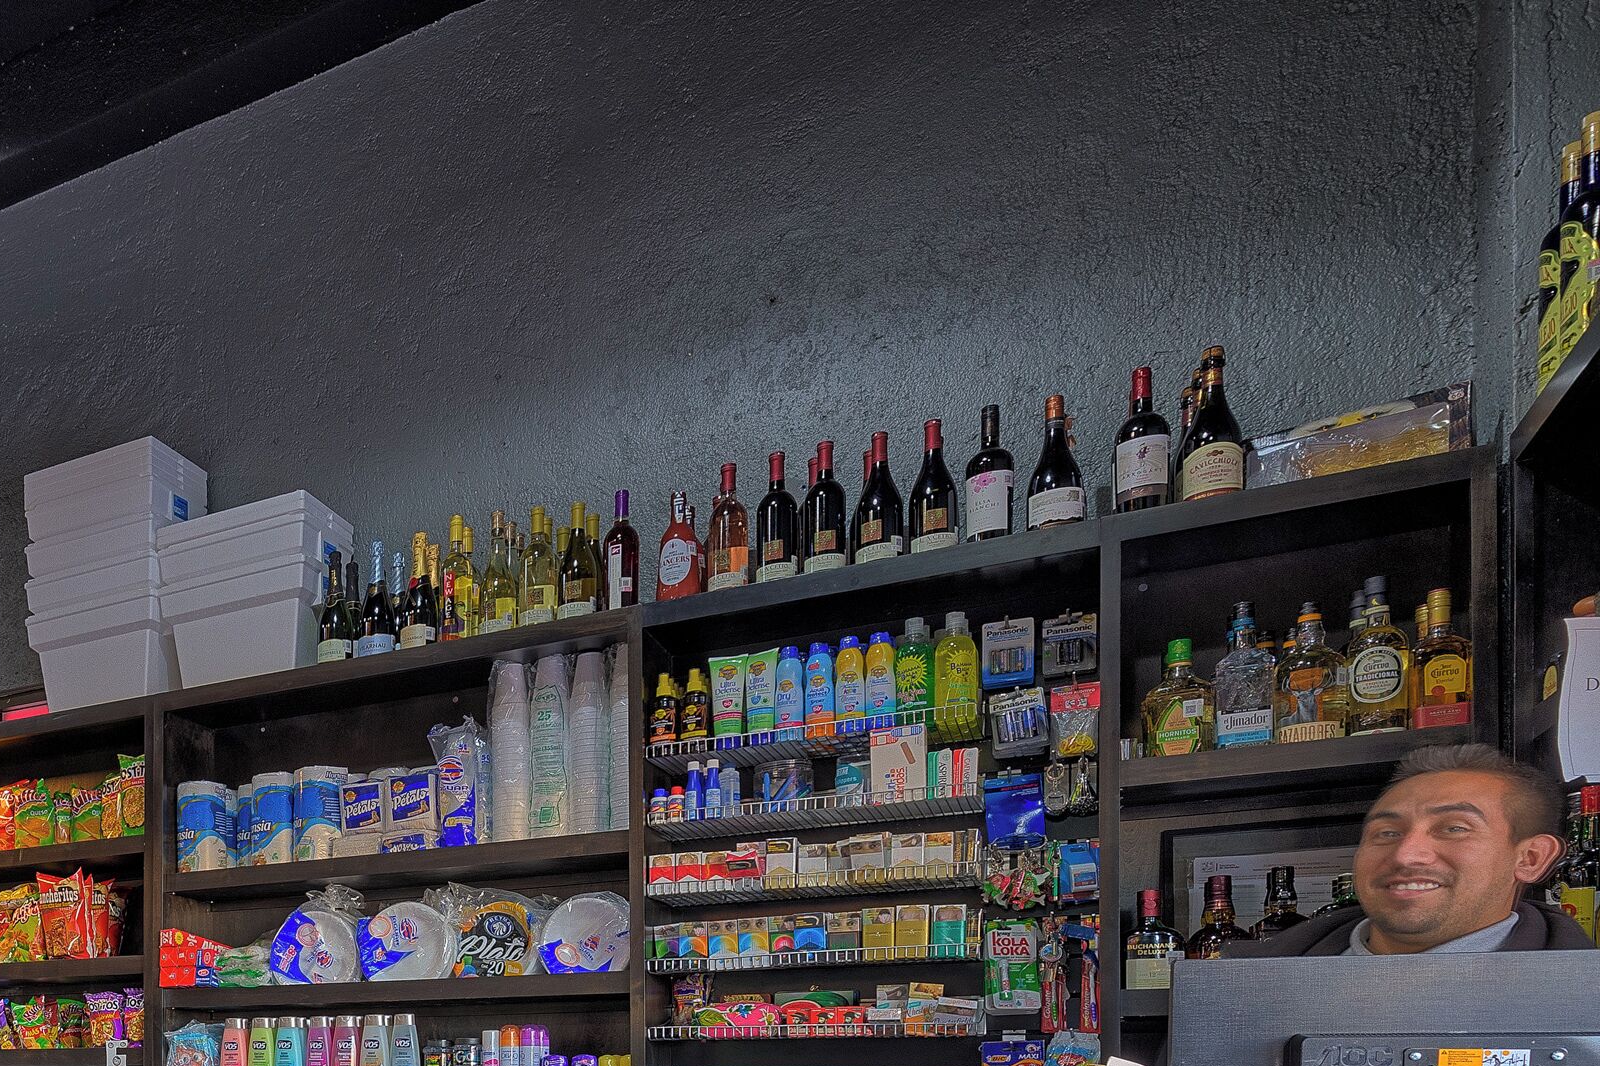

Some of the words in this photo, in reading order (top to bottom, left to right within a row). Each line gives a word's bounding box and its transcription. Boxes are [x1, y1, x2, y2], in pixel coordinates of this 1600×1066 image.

[986, 627, 1029, 638] Panasonic
[1046, 624, 1093, 636] Panasonic
[1354, 670, 1400, 683] TRADICIONAL
[992, 697, 1039, 711] Panasonic
[537, 710, 551, 721] 25
[1158, 728, 1198, 739] HORNITOS
[992, 931, 1030, 946] KOLA
[458, 934, 527, 962] Plato
[992, 946, 1031, 956] LOKA
[487, 960, 506, 975] 20
